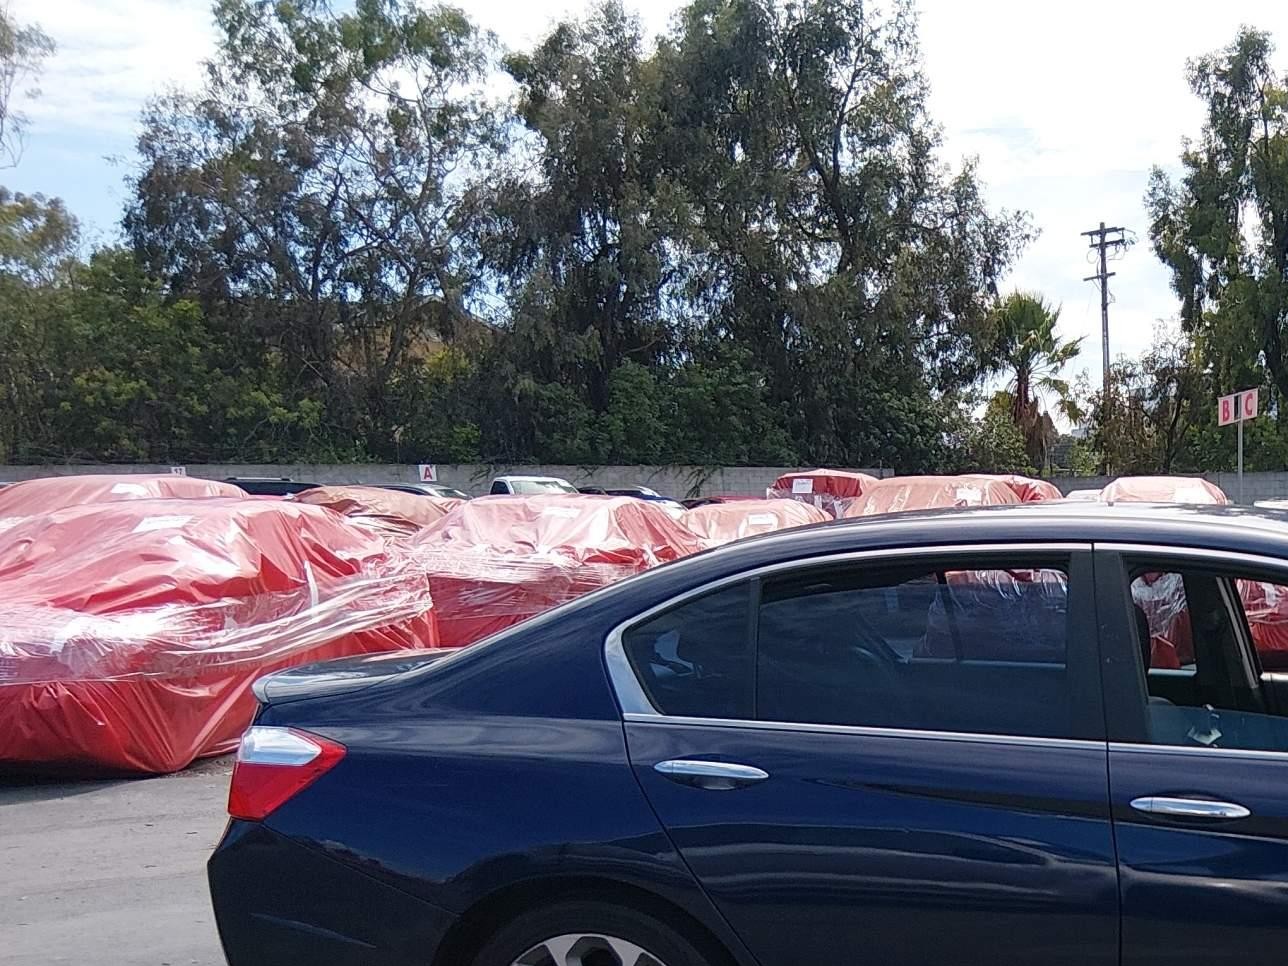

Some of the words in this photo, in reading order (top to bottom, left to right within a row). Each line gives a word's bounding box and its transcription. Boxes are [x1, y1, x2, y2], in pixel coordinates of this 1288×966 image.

[1222, 400, 1230, 422] B
[1244, 393, 1254, 416] C
[423, 466, 433, 480] A
